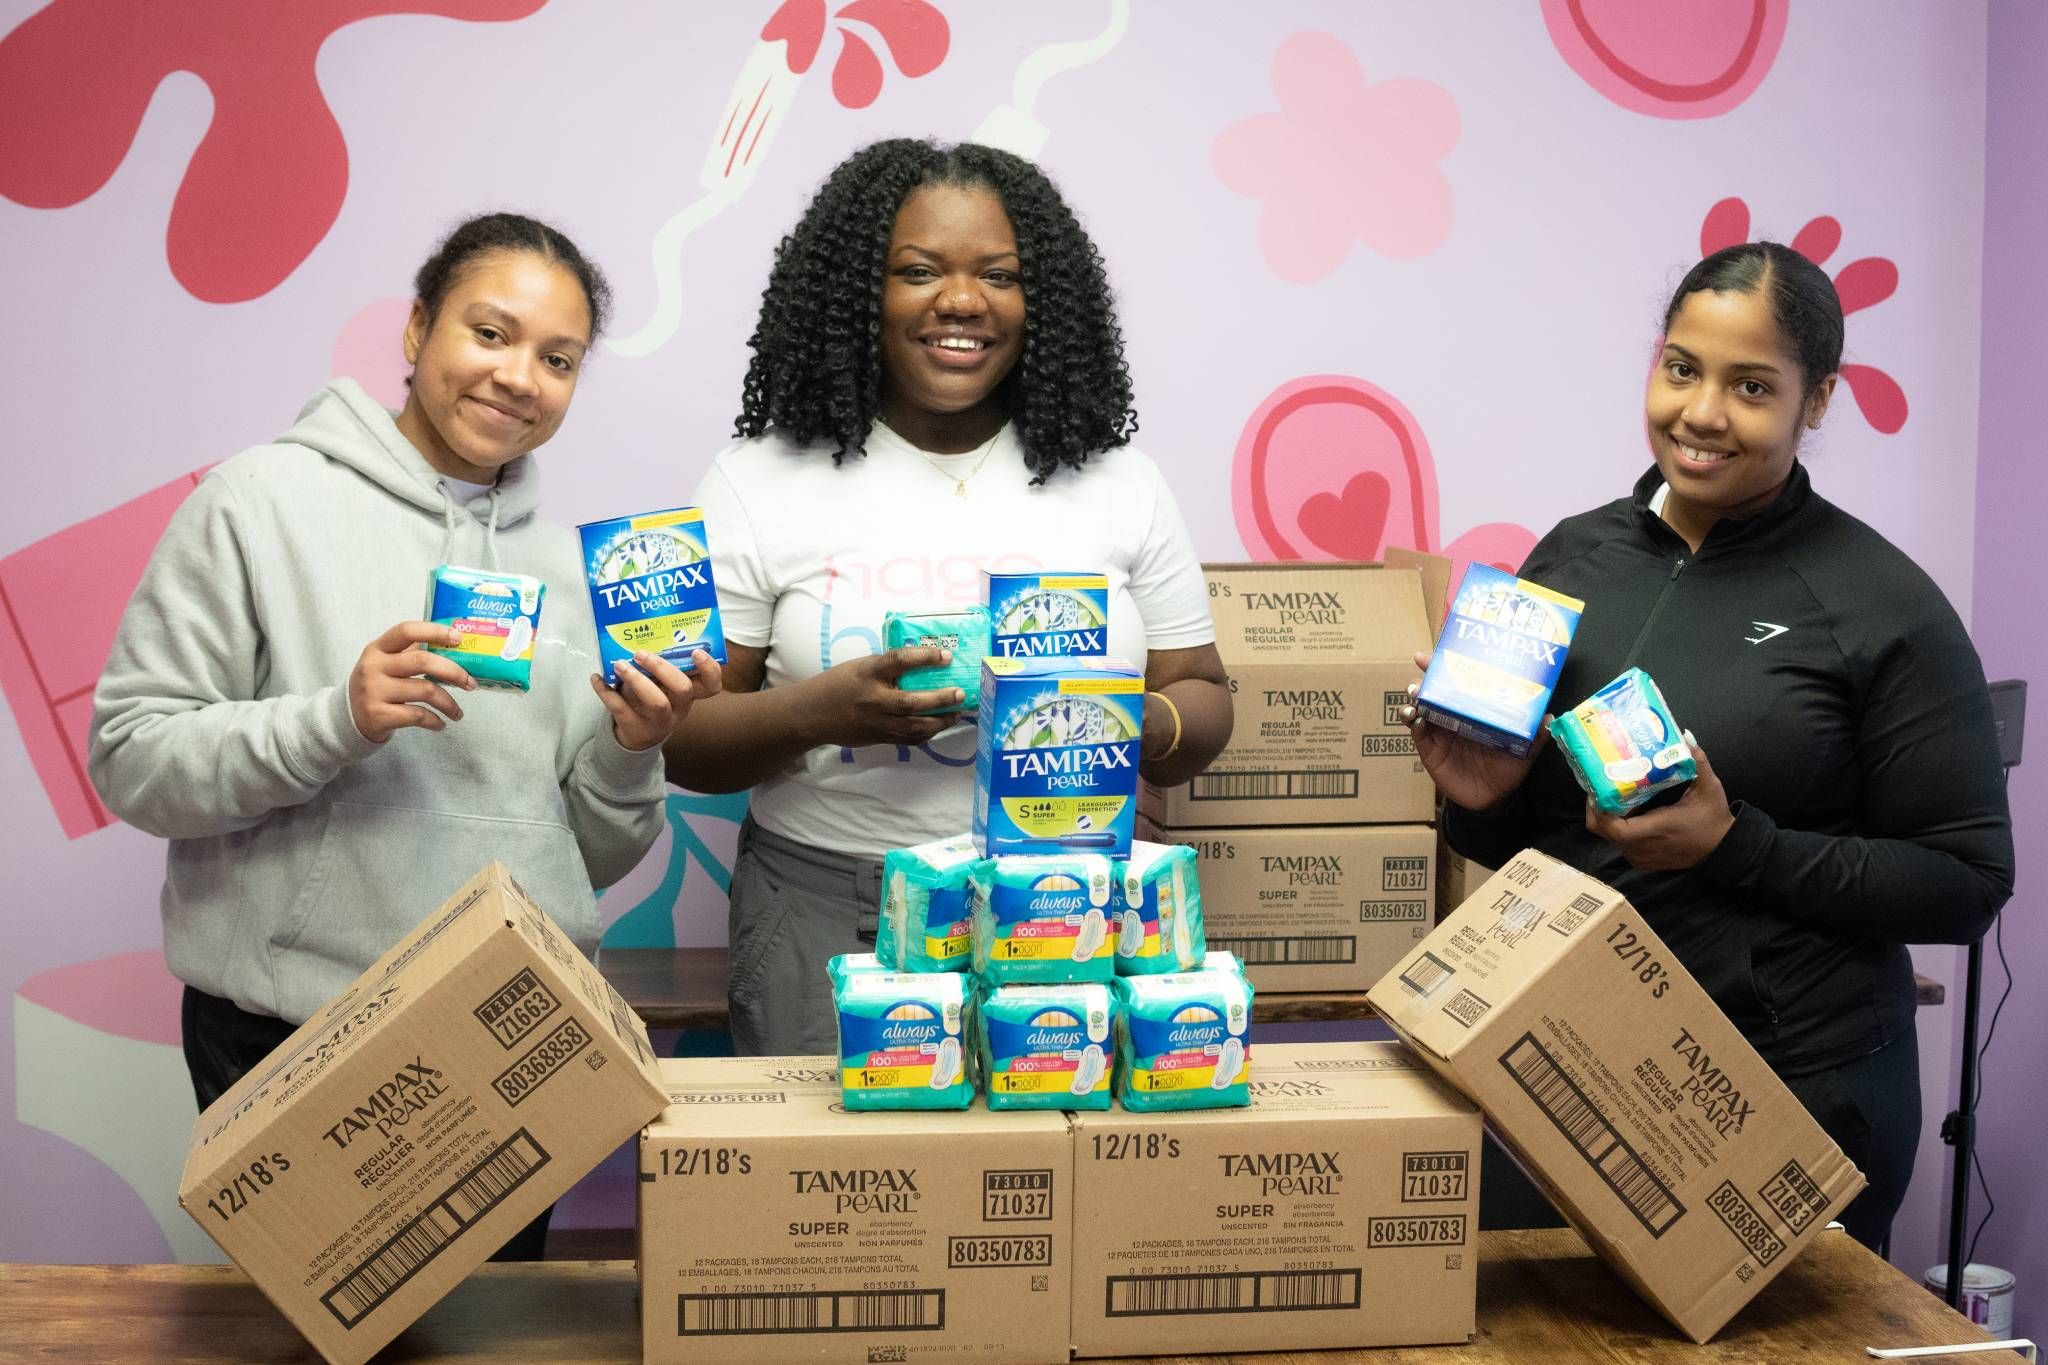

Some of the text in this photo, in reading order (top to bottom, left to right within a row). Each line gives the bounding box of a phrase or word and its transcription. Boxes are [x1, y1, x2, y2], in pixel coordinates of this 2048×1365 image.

[599, 565, 708, 608] TAMPAX
[467, 596, 517, 616] always
[1240, 591, 1343, 610] TAMPAX
[455, 623, 477, 632] 100%
[623, 629, 633, 640] S
[1244, 627, 1294, 635] REGULAR
[997, 631, 1101, 657] TAMPAX
[1244, 634, 1296, 644] RÉGULIER
[1456, 619, 1558, 665] TAMPAX
[1262, 690, 1343, 706] TAMPAX
[1366, 738, 1416, 753] 8036885
[1003, 744, 1131, 778] TAMPAX
[1019, 805, 1030, 818] S
[1260, 856, 1341, 872] TAMPAX
[1389, 860, 1420, 869] 73010
[1387, 872, 1423, 887] 71037
[1030, 893, 1086, 915] always
[1259, 891, 1298, 900] SUPER
[1364, 904, 1422, 918] 80350783
[1490, 889, 1550, 932] TAMPAX
[1017, 927, 1042, 937] 100%
[1459, 925, 1487, 945] REGULAR
[1607, 923, 1669, 998] 12/18's
[486, 981, 528, 1018] 73010
[496, 991, 550, 1039] 71663
[883, 1022, 940, 1042] always
[1027, 1029, 1083, 1049] always
[1169, 1025, 1223, 1044] always
[502, 1026, 582, 1097] 80368858
[871, 1055, 898, 1066] 100%
[1014, 1062, 1040, 1071] 100%
[1158, 1059, 1182, 1069] 100%
[1643, 1057, 1683, 1103] REGULAR
[1672, 1028, 1754, 1125] TAMPAX
[1630, 1078, 1662, 1114] UNSCENTED
[1633, 1064, 1676, 1112] RÉGULIER
[323, 1056, 433, 1147] TAMPAX
[424, 1104, 477, 1150] NON PARFUMÉS
[1668, 1122, 1682, 1138] NON
[353, 1134, 405, 1178] REGULAR
[1092, 1133, 1180, 1160] 12/18's
[360, 1142, 414, 1188] RÉGULIER
[454, 1140, 499, 1179] 80368858
[660, 1149, 751, 1176] 12/18's
[1218, 1152, 1340, 1176] TAMPAX
[1412, 1157, 1457, 1171] 73010
[375, 1157, 415, 1191] UNSCENTED
[789, 1169, 918, 1193] TAMPAX
[994, 1175, 1041, 1190] 73010
[208, 1152, 289, 1220] 12/18's
[1408, 1174, 1462, 1197] 71037
[1787, 1170, 1821, 1206] 73010
[989, 1193, 1047, 1215] 71037
[1216, 1204, 1274, 1218] SUPER
[1767, 1180, 1810, 1227] 71663
[789, 1222, 849, 1235] SUPER
[1221, 1223, 1268, 1231] UNSCENTED
[1299, 1220, 1344, 1229] FRAGANCIA
[1374, 1219, 1460, 1243] 80350783
[1714, 1189, 1781, 1258] 80368858
[955, 1240, 1046, 1263] 80350783
[1332, 1244, 1355, 1252] TOTAL
[762, 1257, 799, 1265] TAMPONS
[840, 1255, 877, 1264] TAMPONS
[879, 1255, 904, 1263] TOTAL
[1161, 1265, 1190, 1274] 73010
[1197, 1264, 1228, 1273] 71037
[734, 1284, 765, 1292] 73010
[773, 1283, 804, 1292] 71037
[863, 1281, 916, 1289] 80350783
